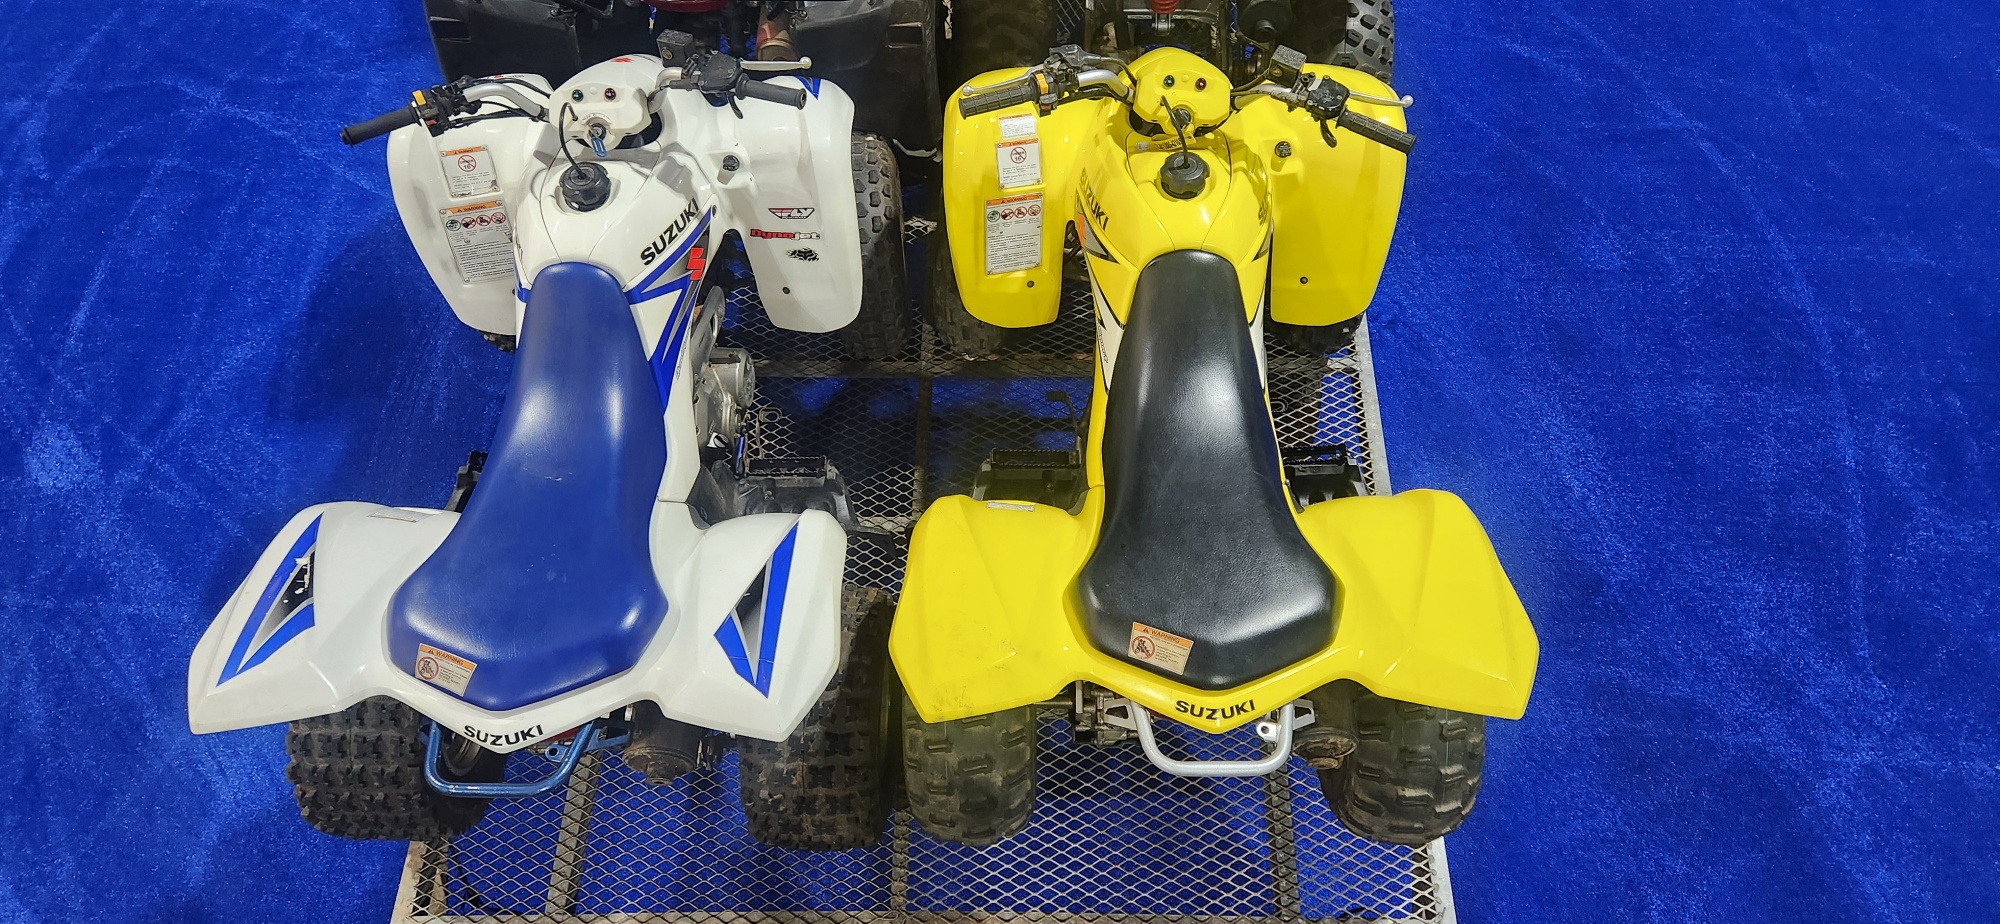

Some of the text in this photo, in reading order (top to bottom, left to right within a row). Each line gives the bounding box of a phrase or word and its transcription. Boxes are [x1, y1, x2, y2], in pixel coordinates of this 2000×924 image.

[770, 208, 814, 217] FLY
[640, 197, 700, 266] SUZUKI
[1151, 629, 1181, 644] WARNING
[436, 650, 465, 666] WARNING
[1175, 699, 1256, 720] SUZUKI
[463, 724, 544, 746] SUZUKI
